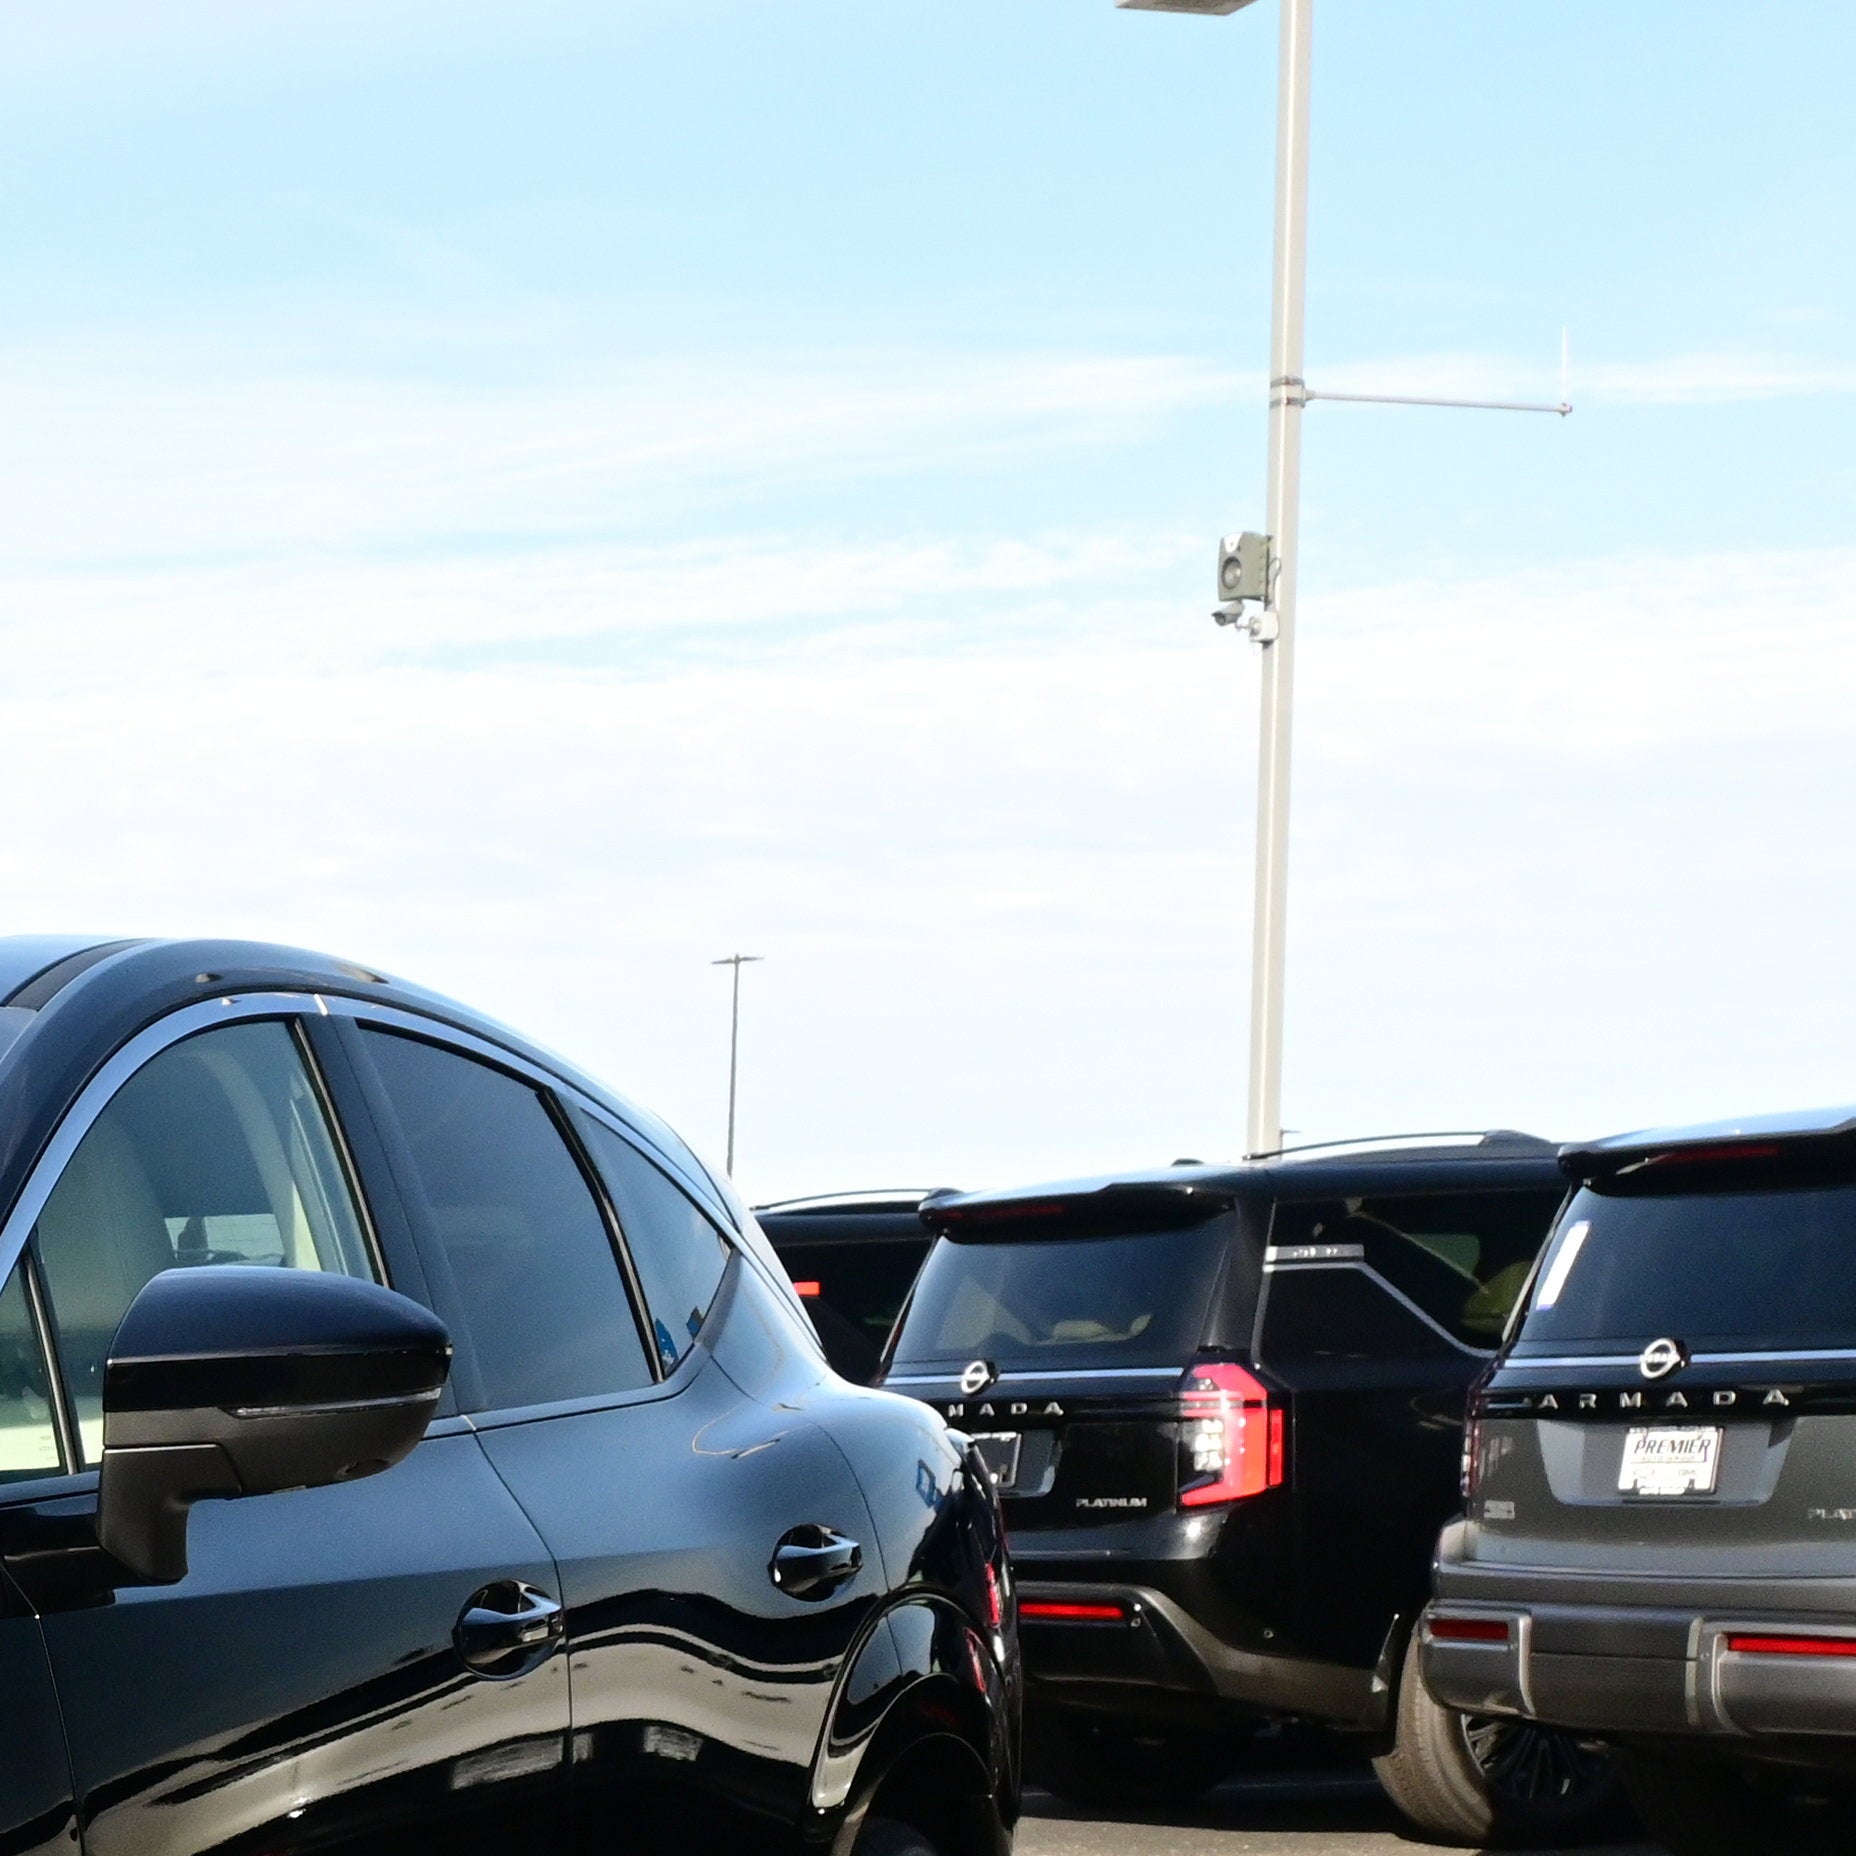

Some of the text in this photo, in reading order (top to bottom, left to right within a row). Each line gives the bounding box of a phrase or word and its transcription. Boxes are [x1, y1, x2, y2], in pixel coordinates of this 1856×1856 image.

[1538, 1388, 1790, 1410] ARMADA
[948, 1402, 1064, 1417] MADA
[1634, 1439, 1711, 1462] PREMIER
[1075, 1497, 1148, 1508] PLATINUM
[1808, 1508, 1856, 1520] PLAT
